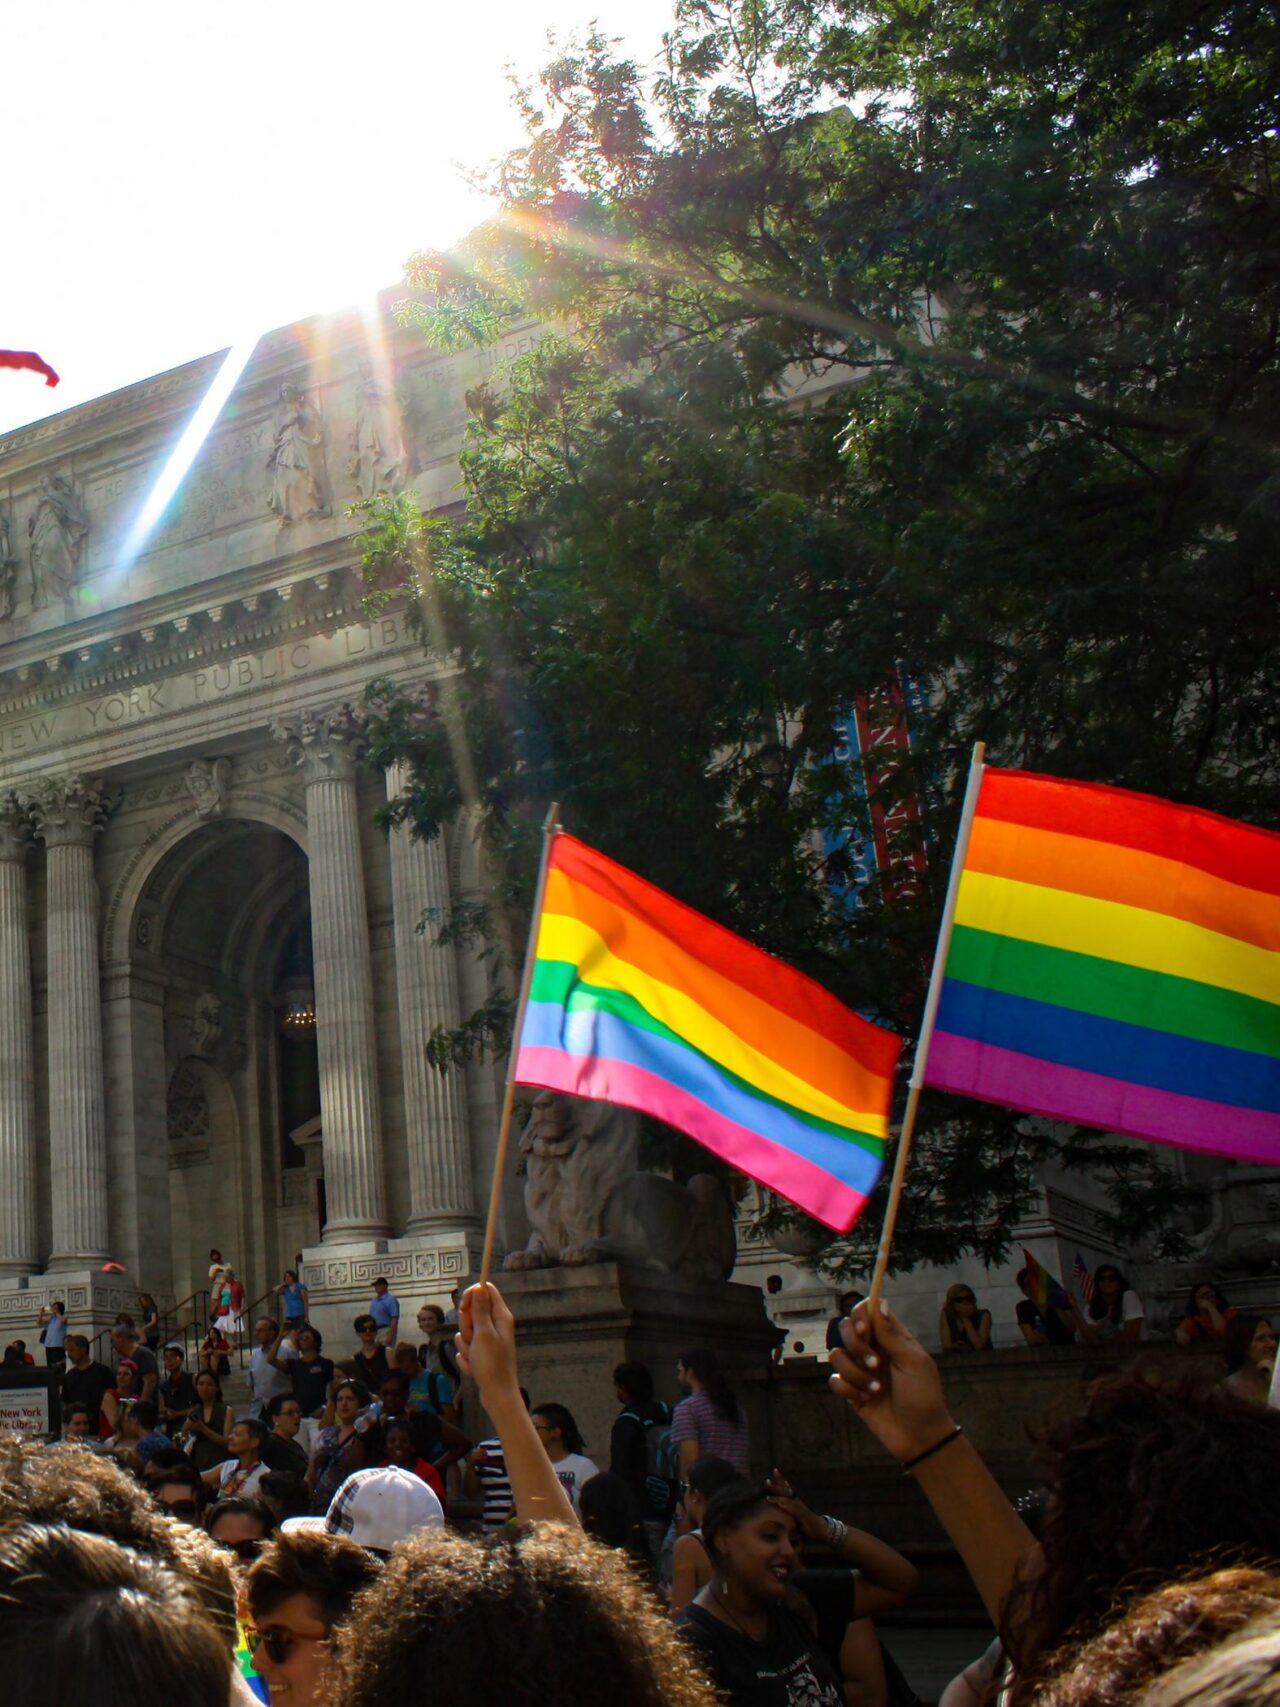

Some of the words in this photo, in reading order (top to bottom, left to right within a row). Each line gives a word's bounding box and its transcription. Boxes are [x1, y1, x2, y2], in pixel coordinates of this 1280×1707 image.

[85, 682, 166, 727] YORK
[193, 644, 311, 699] PUBLIC
[344, 619, 404, 657] LIB
[0, 1408, 20, 1419] New
[22, 1407, 42, 1417] York
